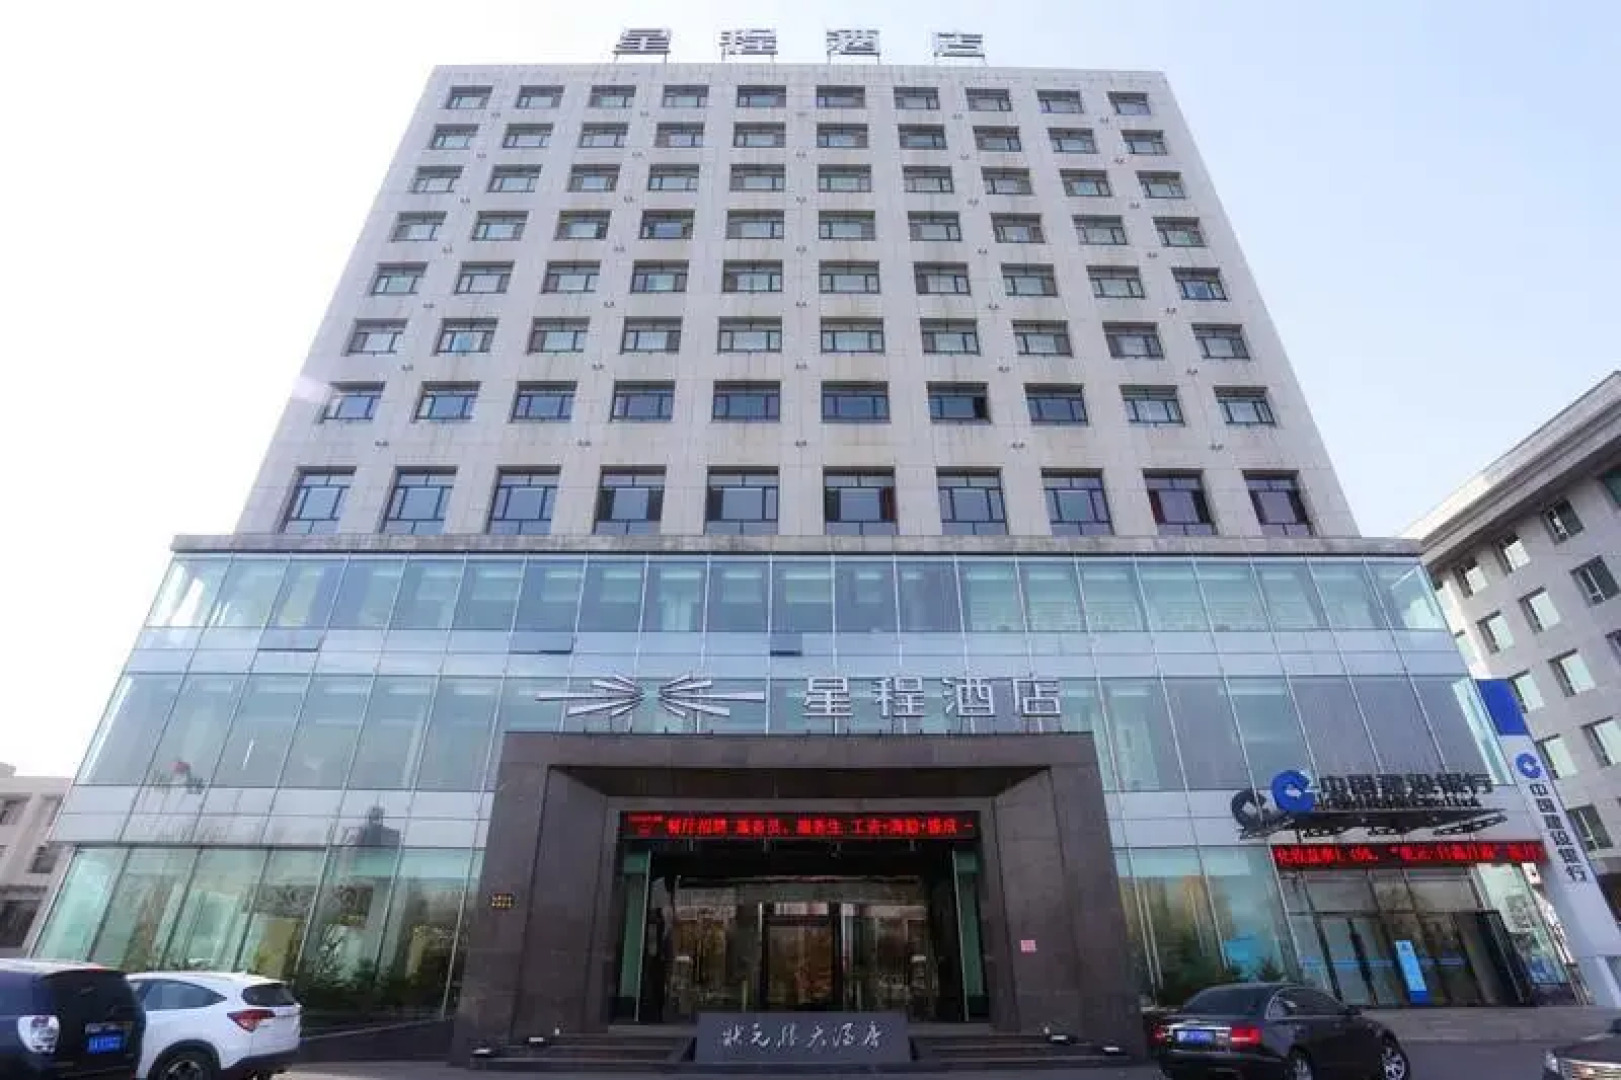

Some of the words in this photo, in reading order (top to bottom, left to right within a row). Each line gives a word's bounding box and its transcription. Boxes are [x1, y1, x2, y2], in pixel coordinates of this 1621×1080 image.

[613, 28, 985, 57] 星程酒店
[803, 676, 1063, 717] 星程酒店
[1529, 783, 1587, 881] 中国建设银行
